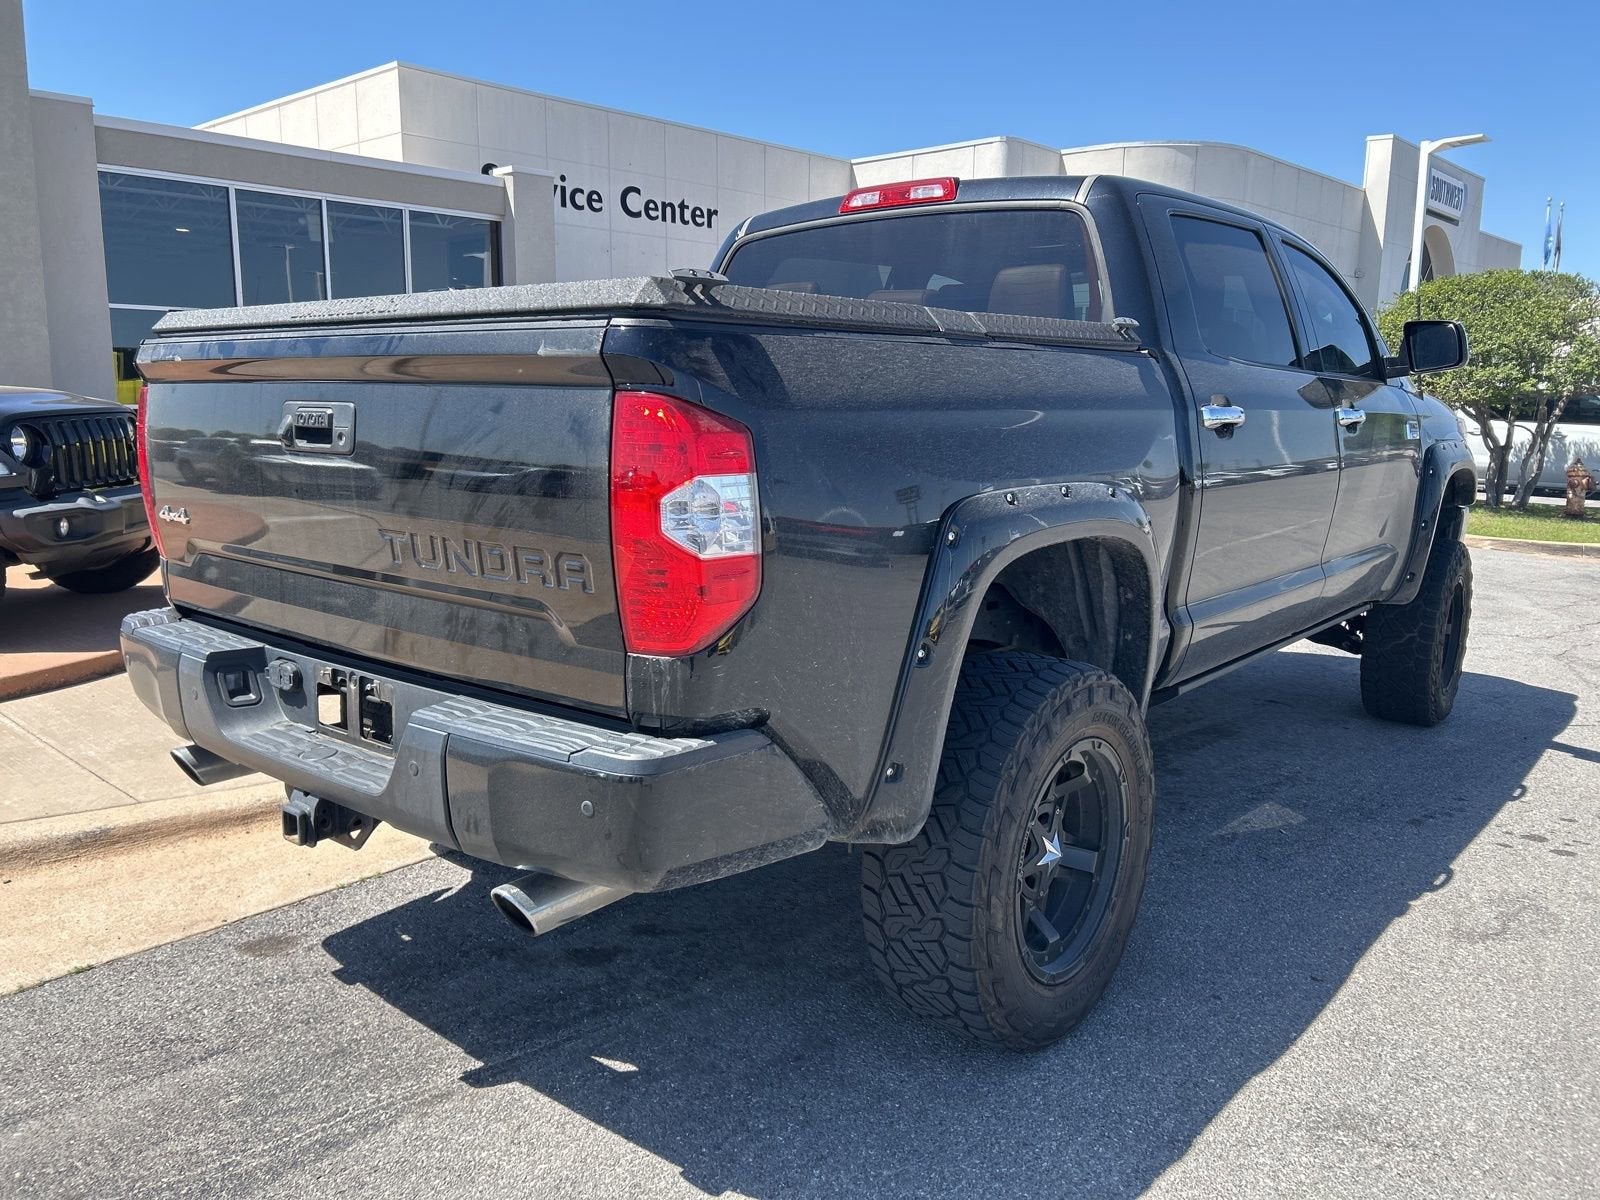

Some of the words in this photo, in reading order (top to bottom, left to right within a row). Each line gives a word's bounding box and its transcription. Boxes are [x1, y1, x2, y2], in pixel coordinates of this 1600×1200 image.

[619, 185, 719, 229] Center
[1430, 175, 1464, 212] SOUTHWEST
[159, 505, 190, 525] 4x4
[378, 528, 595, 594] TUNDRA
